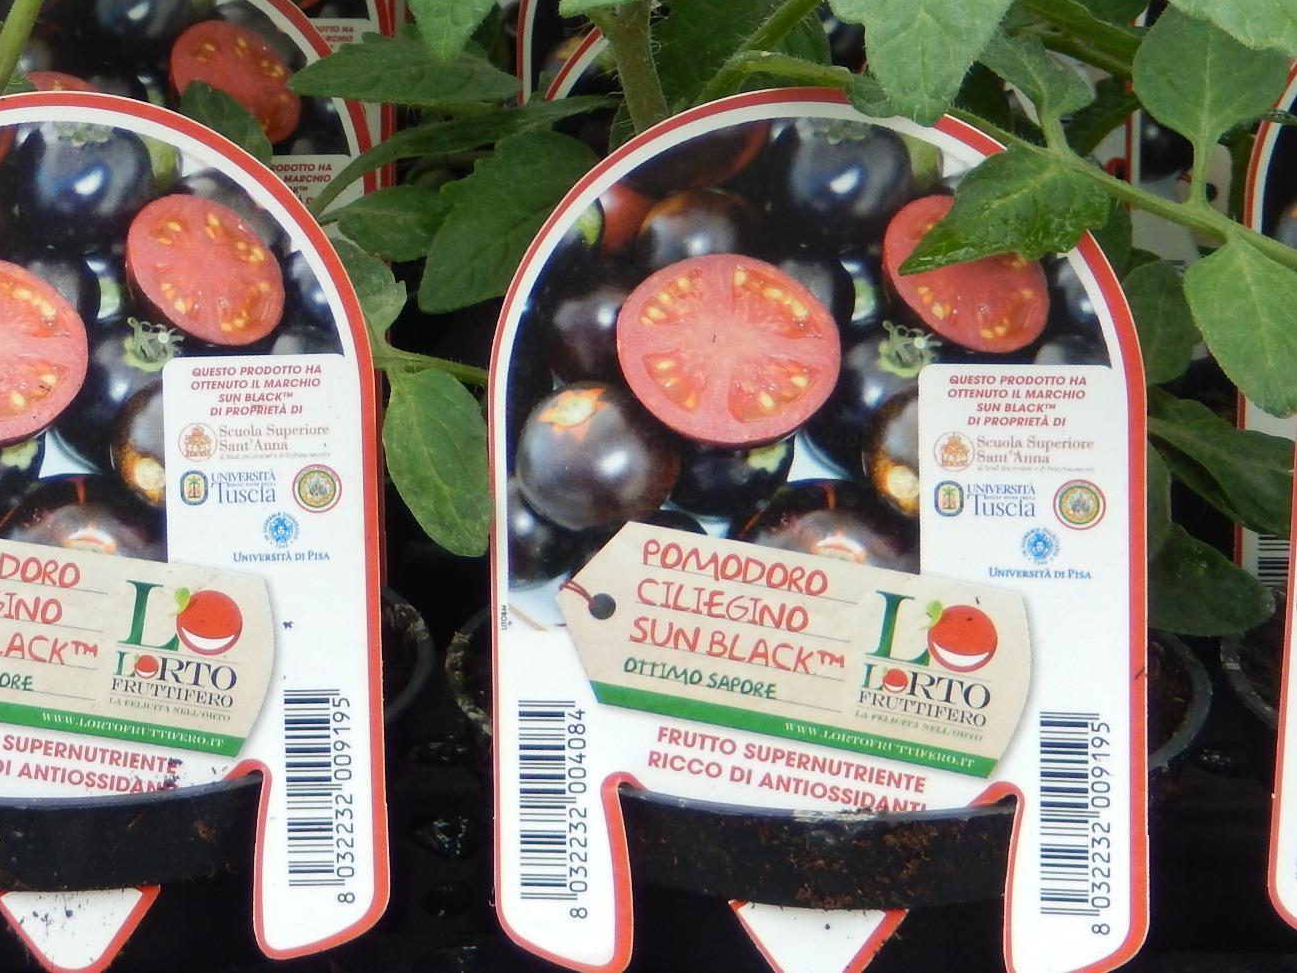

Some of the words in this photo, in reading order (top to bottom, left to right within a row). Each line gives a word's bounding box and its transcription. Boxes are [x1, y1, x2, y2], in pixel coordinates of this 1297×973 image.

[192, 366, 235, 377] QUESTO
[239, 365, 302, 376] PRODOTTO
[305, 364, 322, 374] HA
[190, 379, 248, 390] OTTENUTO
[251, 379, 261, 389] IL
[264, 378, 321, 388] MARCHIO
[949, 375, 996, 386] QUESTO
[999, 375, 1065, 386] PRODOTTO
[1069, 376, 1087, 386] HA
[218, 393, 242, 403] SUN
[947, 389, 1008, 399] OTTENUTO
[1011, 389, 1022, 399] IL
[1025, 389, 1086, 400] MARCHIO
[210, 407, 222, 416] DI
[225, 403, 287, 416] PROPRIETÀ
[291, 405, 303, 414] DI
[976, 403, 1002, 412] SUN
[967, 417, 980, 426] DI
[983, 414, 1049, 427] PROPRIETÀ
[1053, 417, 1066, 427] DI
[218, 425, 262, 438] Scuola
[266, 424, 329, 439] Superiore
[219, 438, 289, 452] Sant'Anna
[976, 435, 1023, 449] Scuola
[1026, 436, 1094, 452] Superiore
[211, 468, 276, 482] UNIVERSITÀ
[211, 482, 276, 504] Tuscia
[967, 483, 1036, 495] UNIVERSITÀ
[967, 494, 1036, 517] Tuscia
[233, 550, 292, 562] UNIVERSITÀ
[307, 550, 330, 561] PISA
[642, 538, 829, 596] POMODORO
[988, 567, 1051, 579] UNIVERSITÀ
[1067, 569, 1092, 580] PISA
[636, 578, 809, 633] CILIEGINO
[629, 616, 701, 653] SUN
[623, 657, 703, 685] OTTIMO
[706, 672, 777, 700] SAPORE
[110, 677, 234, 708] FRUTTIFERO
[857, 691, 987, 728] FRUTTIFERO
[332, 697, 352, 781] 009195
[2, 734, 182, 775] SUPERNUTRIENTE
[568, 708, 587, 795] 004084
[657, 726, 737, 756] FRUTTO
[743, 742, 926, 794] SUPERNUTRIENTE
[647, 750, 723, 779] RICCO
[730, 762, 753, 785] DI
[1091, 722, 1111, 809] 009195
[335, 793, 355, 878] 032232
[569, 806, 588, 893] 032232
[1091, 821, 1111, 909] 032232
[337, 891, 356, 904] 8
[569, 907, 588, 919] 8
[1091, 923, 1111, 935] 8
